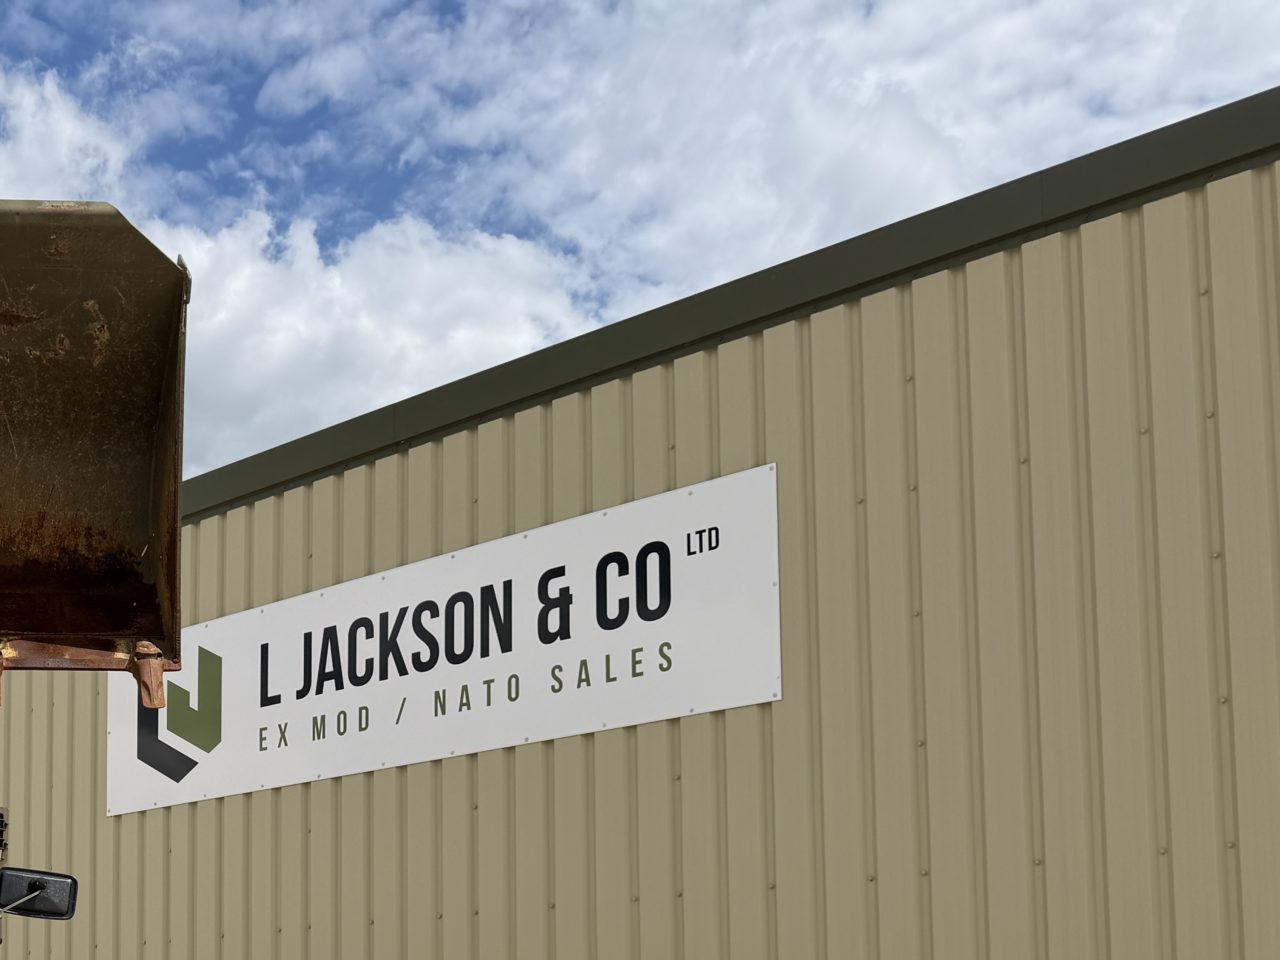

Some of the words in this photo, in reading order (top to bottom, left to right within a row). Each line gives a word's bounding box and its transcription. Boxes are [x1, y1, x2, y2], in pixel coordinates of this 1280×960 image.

[260, 642, 282, 709] L
[295, 578, 513, 701] JACKSON
[536, 564, 574, 645] &
[595, 540, 672, 631] CO
[685, 526, 720, 557] LTD
[259, 722, 289, 752] EX
[311, 705, 370, 742] MOD
[395, 697, 407, 725] /
[433, 673, 520, 718] NATO
[550, 641, 673, 694] SALES
